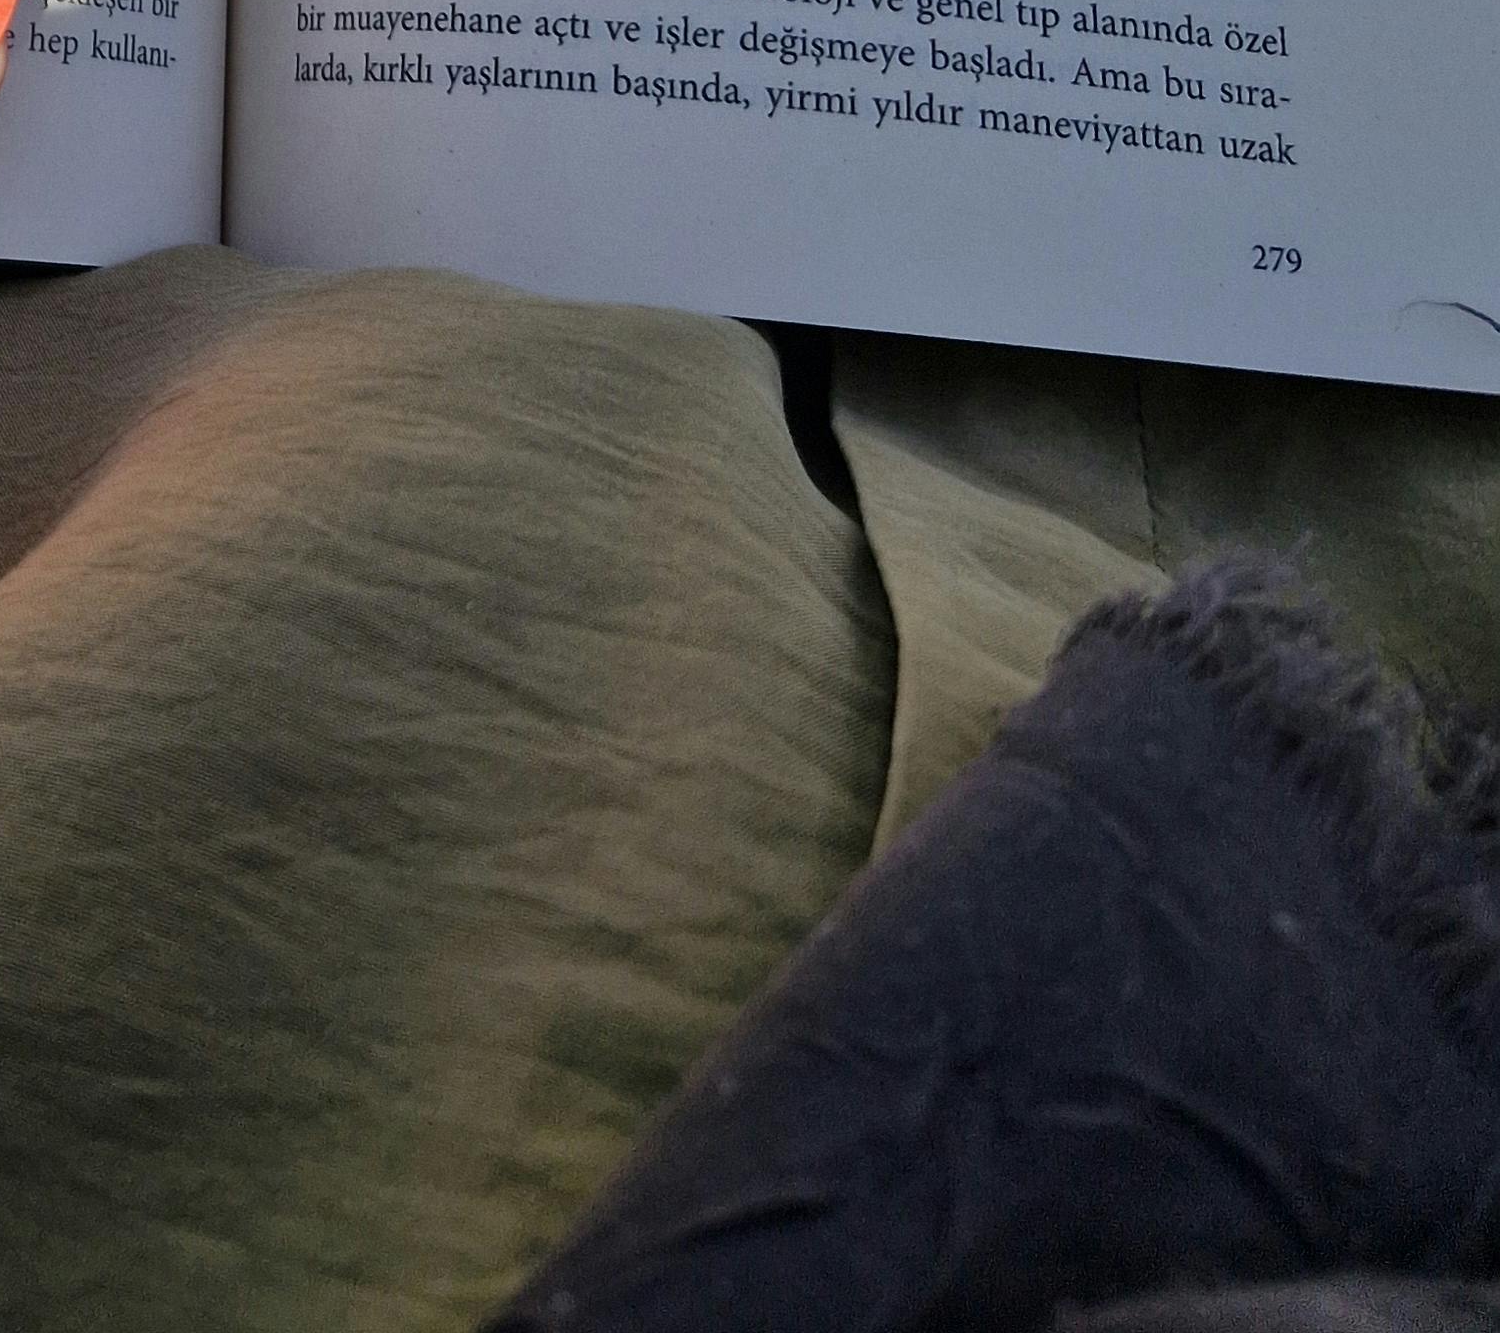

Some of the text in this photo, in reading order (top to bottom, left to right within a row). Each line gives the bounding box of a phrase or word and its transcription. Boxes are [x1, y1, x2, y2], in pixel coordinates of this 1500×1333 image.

[28, 23, 176, 69] hep kullanı-
[297, 2, 1292, 109] bir muayenehane açtı ve işler değişmeye başladı. Ama bu sıra-
[1015, 0, 1060, 38] tıp
[1069, 3, 1214, 48] alanında
[1225, 22, 1289, 57] özel
[294, 52, 1298, 165] larda, kırklı yaşlarının başında, yirmi yıldır maneviyattan uzak
[1253, 245, 1302, 273] 279
